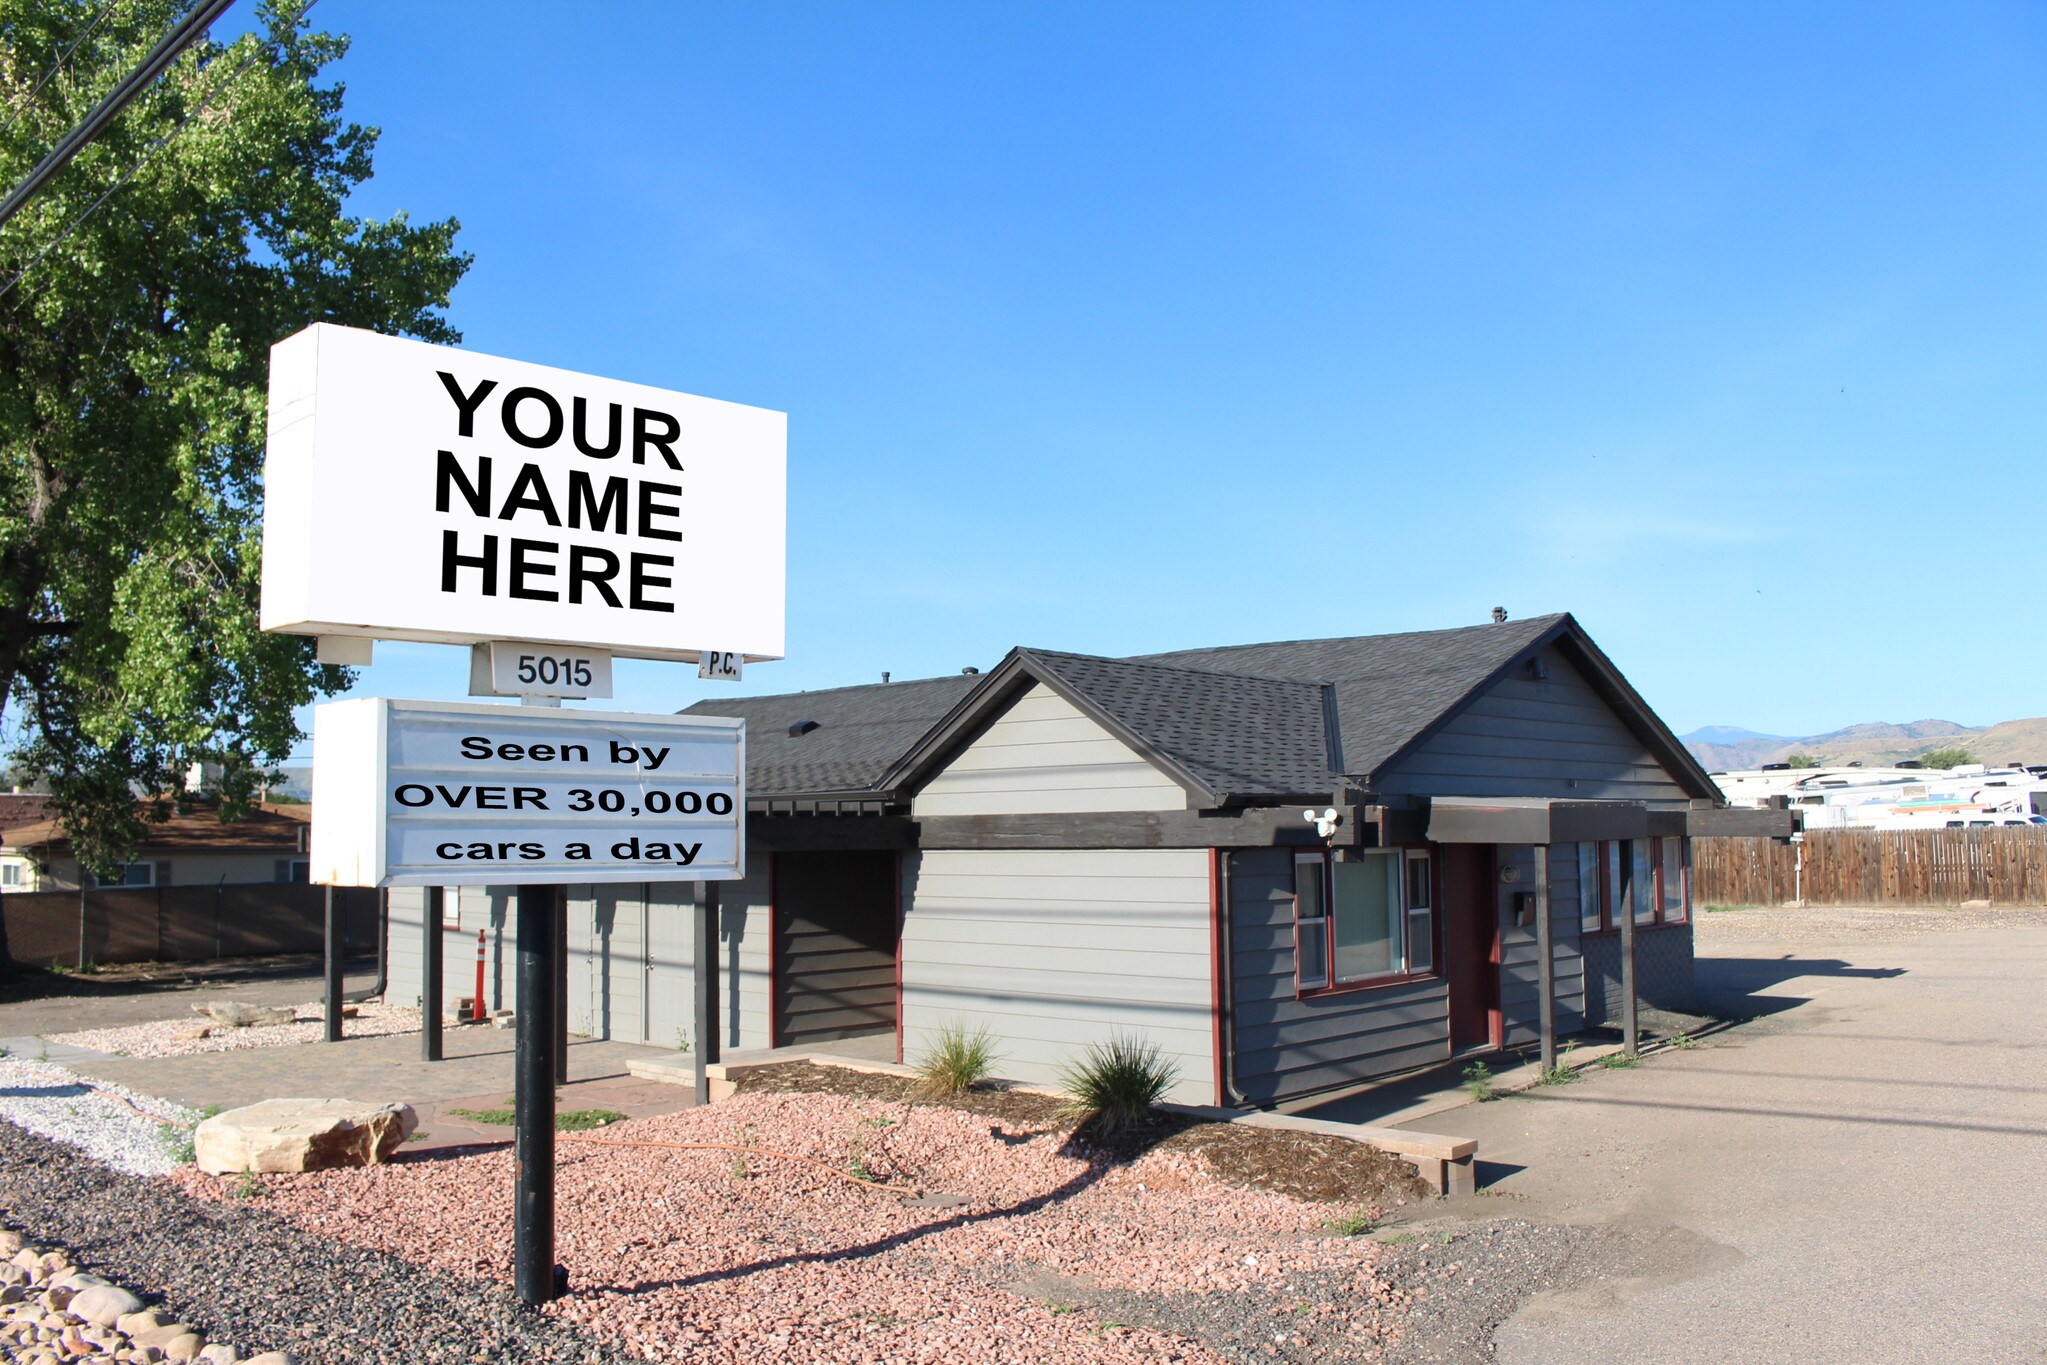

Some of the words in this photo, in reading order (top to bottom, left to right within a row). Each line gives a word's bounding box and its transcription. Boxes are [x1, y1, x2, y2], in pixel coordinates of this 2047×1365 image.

[436, 371, 684, 471] YOUR
[436, 450, 682, 542] NAME
[442, 530, 674, 613] HERE
[518, 655, 593, 687] 5015
[461, 737, 589, 762] Seen
[610, 740, 671, 771] by
[395, 785, 550, 811] OVER
[567, 788, 733, 817] 30,000
[436, 842, 546, 860] cars
[565, 842, 593, 860] a
[611, 837, 703, 866] day
